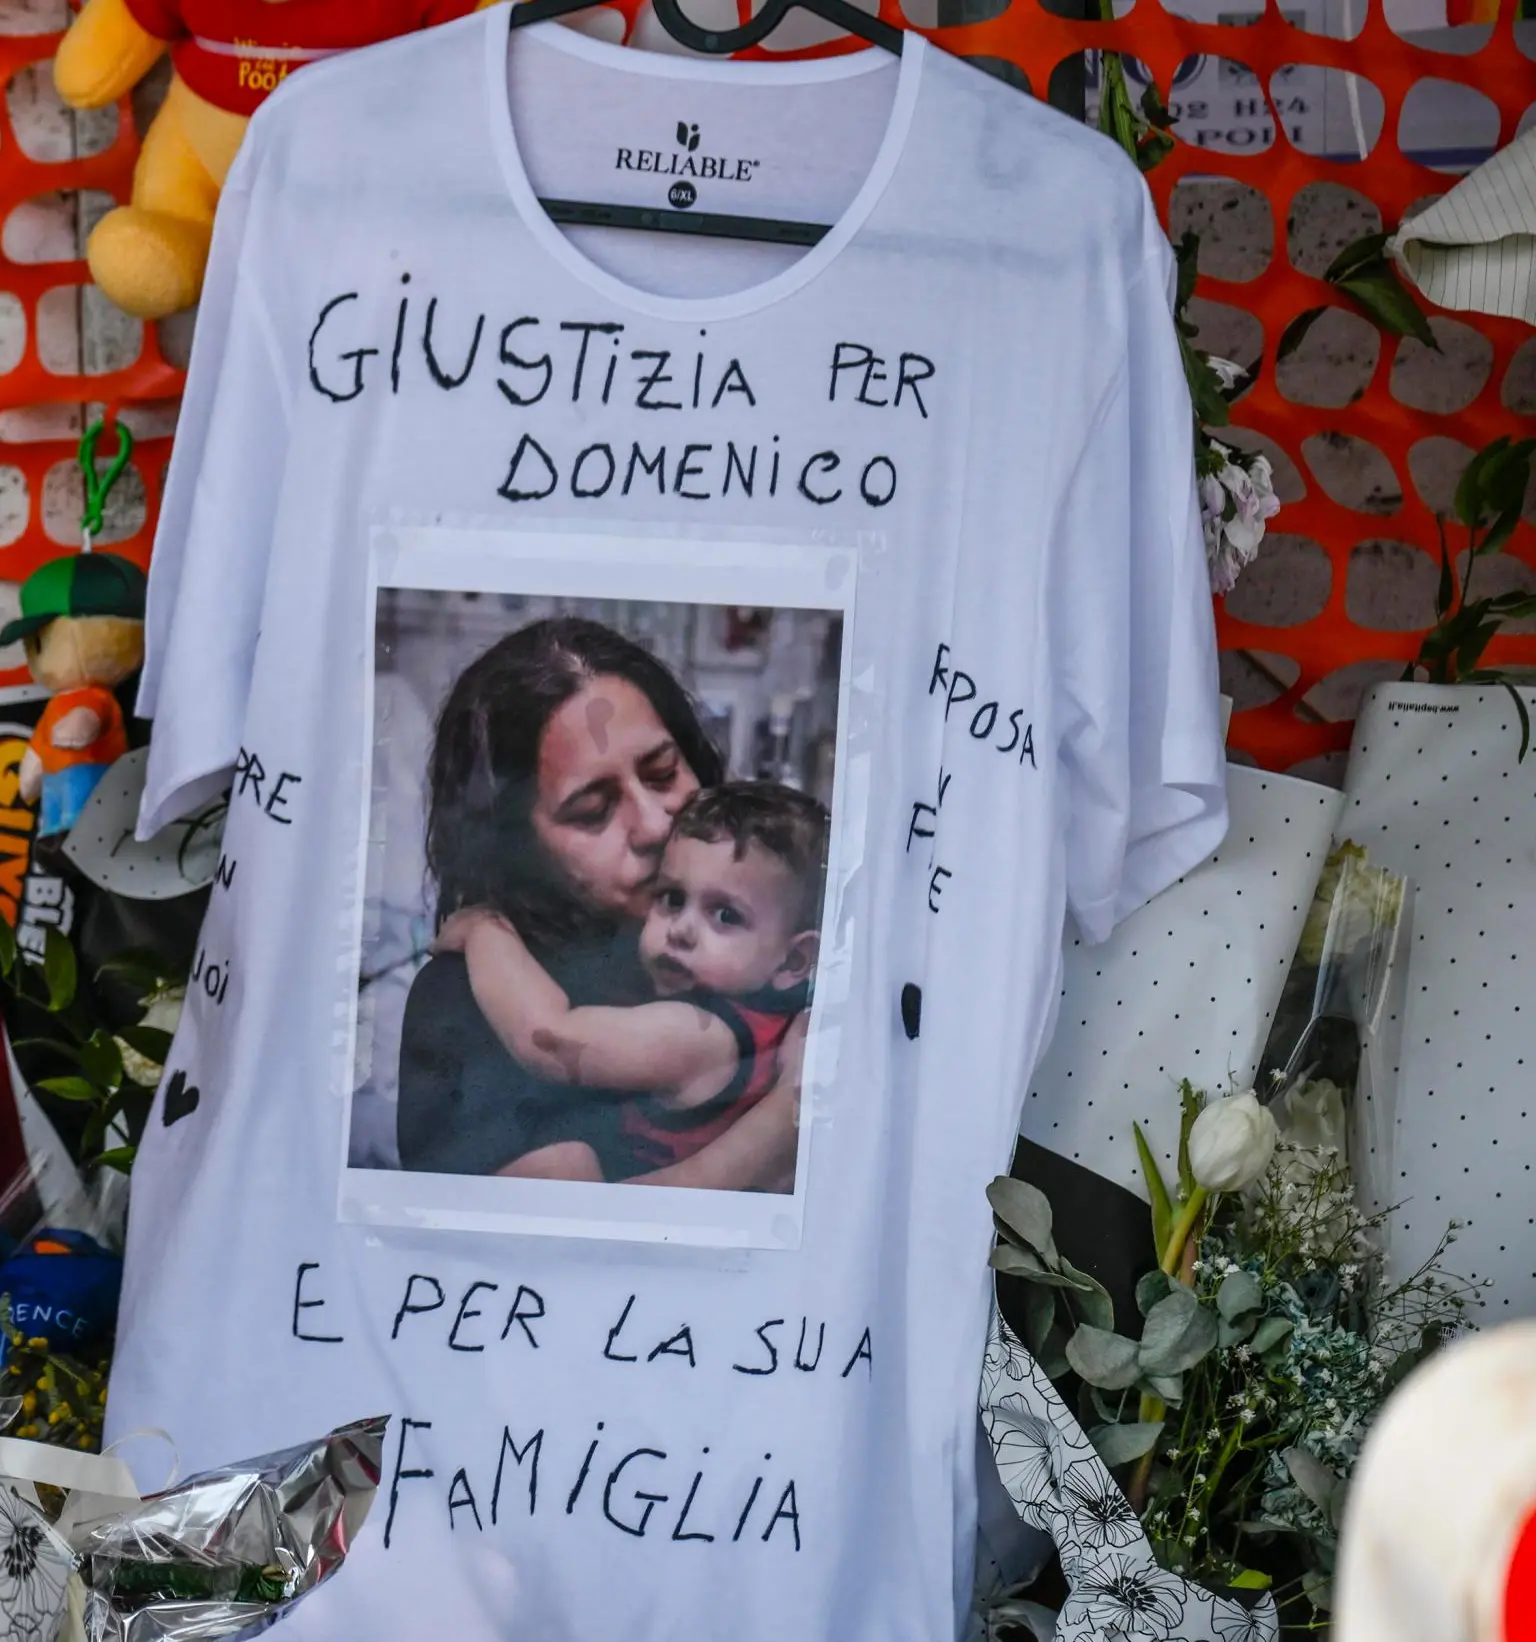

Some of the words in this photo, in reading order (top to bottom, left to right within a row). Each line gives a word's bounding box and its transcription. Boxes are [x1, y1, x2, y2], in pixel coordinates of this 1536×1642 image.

[828, 342, 936, 419] PER
[236, 746, 302, 824] PRE
[292, 1262, 345, 1342] E
[391, 1274, 547, 1352] PER
[603, 1294, 697, 1369] LA
[732, 1316, 873, 1380] SUA
